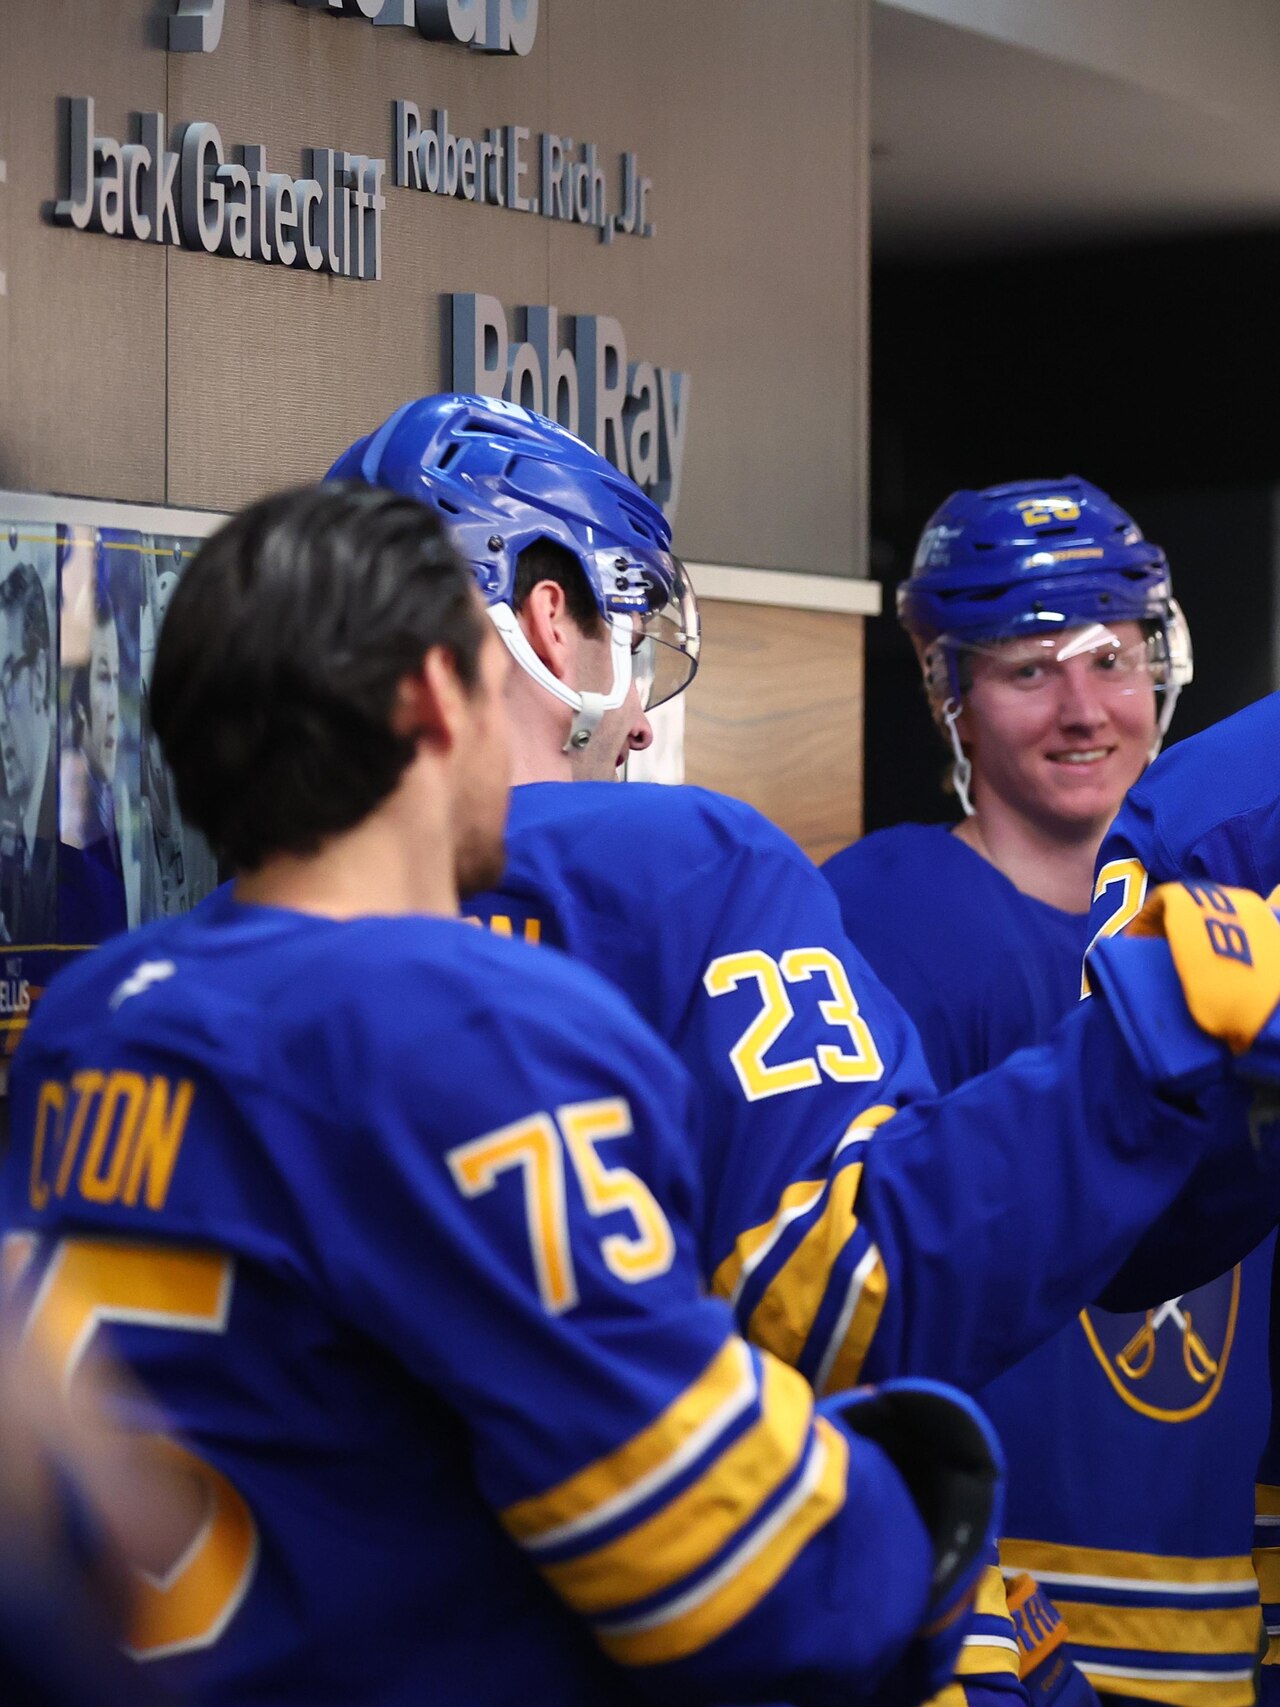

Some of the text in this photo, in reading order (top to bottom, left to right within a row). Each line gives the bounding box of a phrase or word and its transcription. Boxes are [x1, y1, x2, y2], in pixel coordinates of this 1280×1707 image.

[56, 97, 386, 281] Jack Gatecliff
[396, 100, 504, 207] Robert
[507, 125, 538, 213] E.
[619, 152, 656, 238] Jr.
[576, 315, 690, 526] Ray
[703, 946, 885, 1102] 23
[446, 1096, 676, 1317] 75
